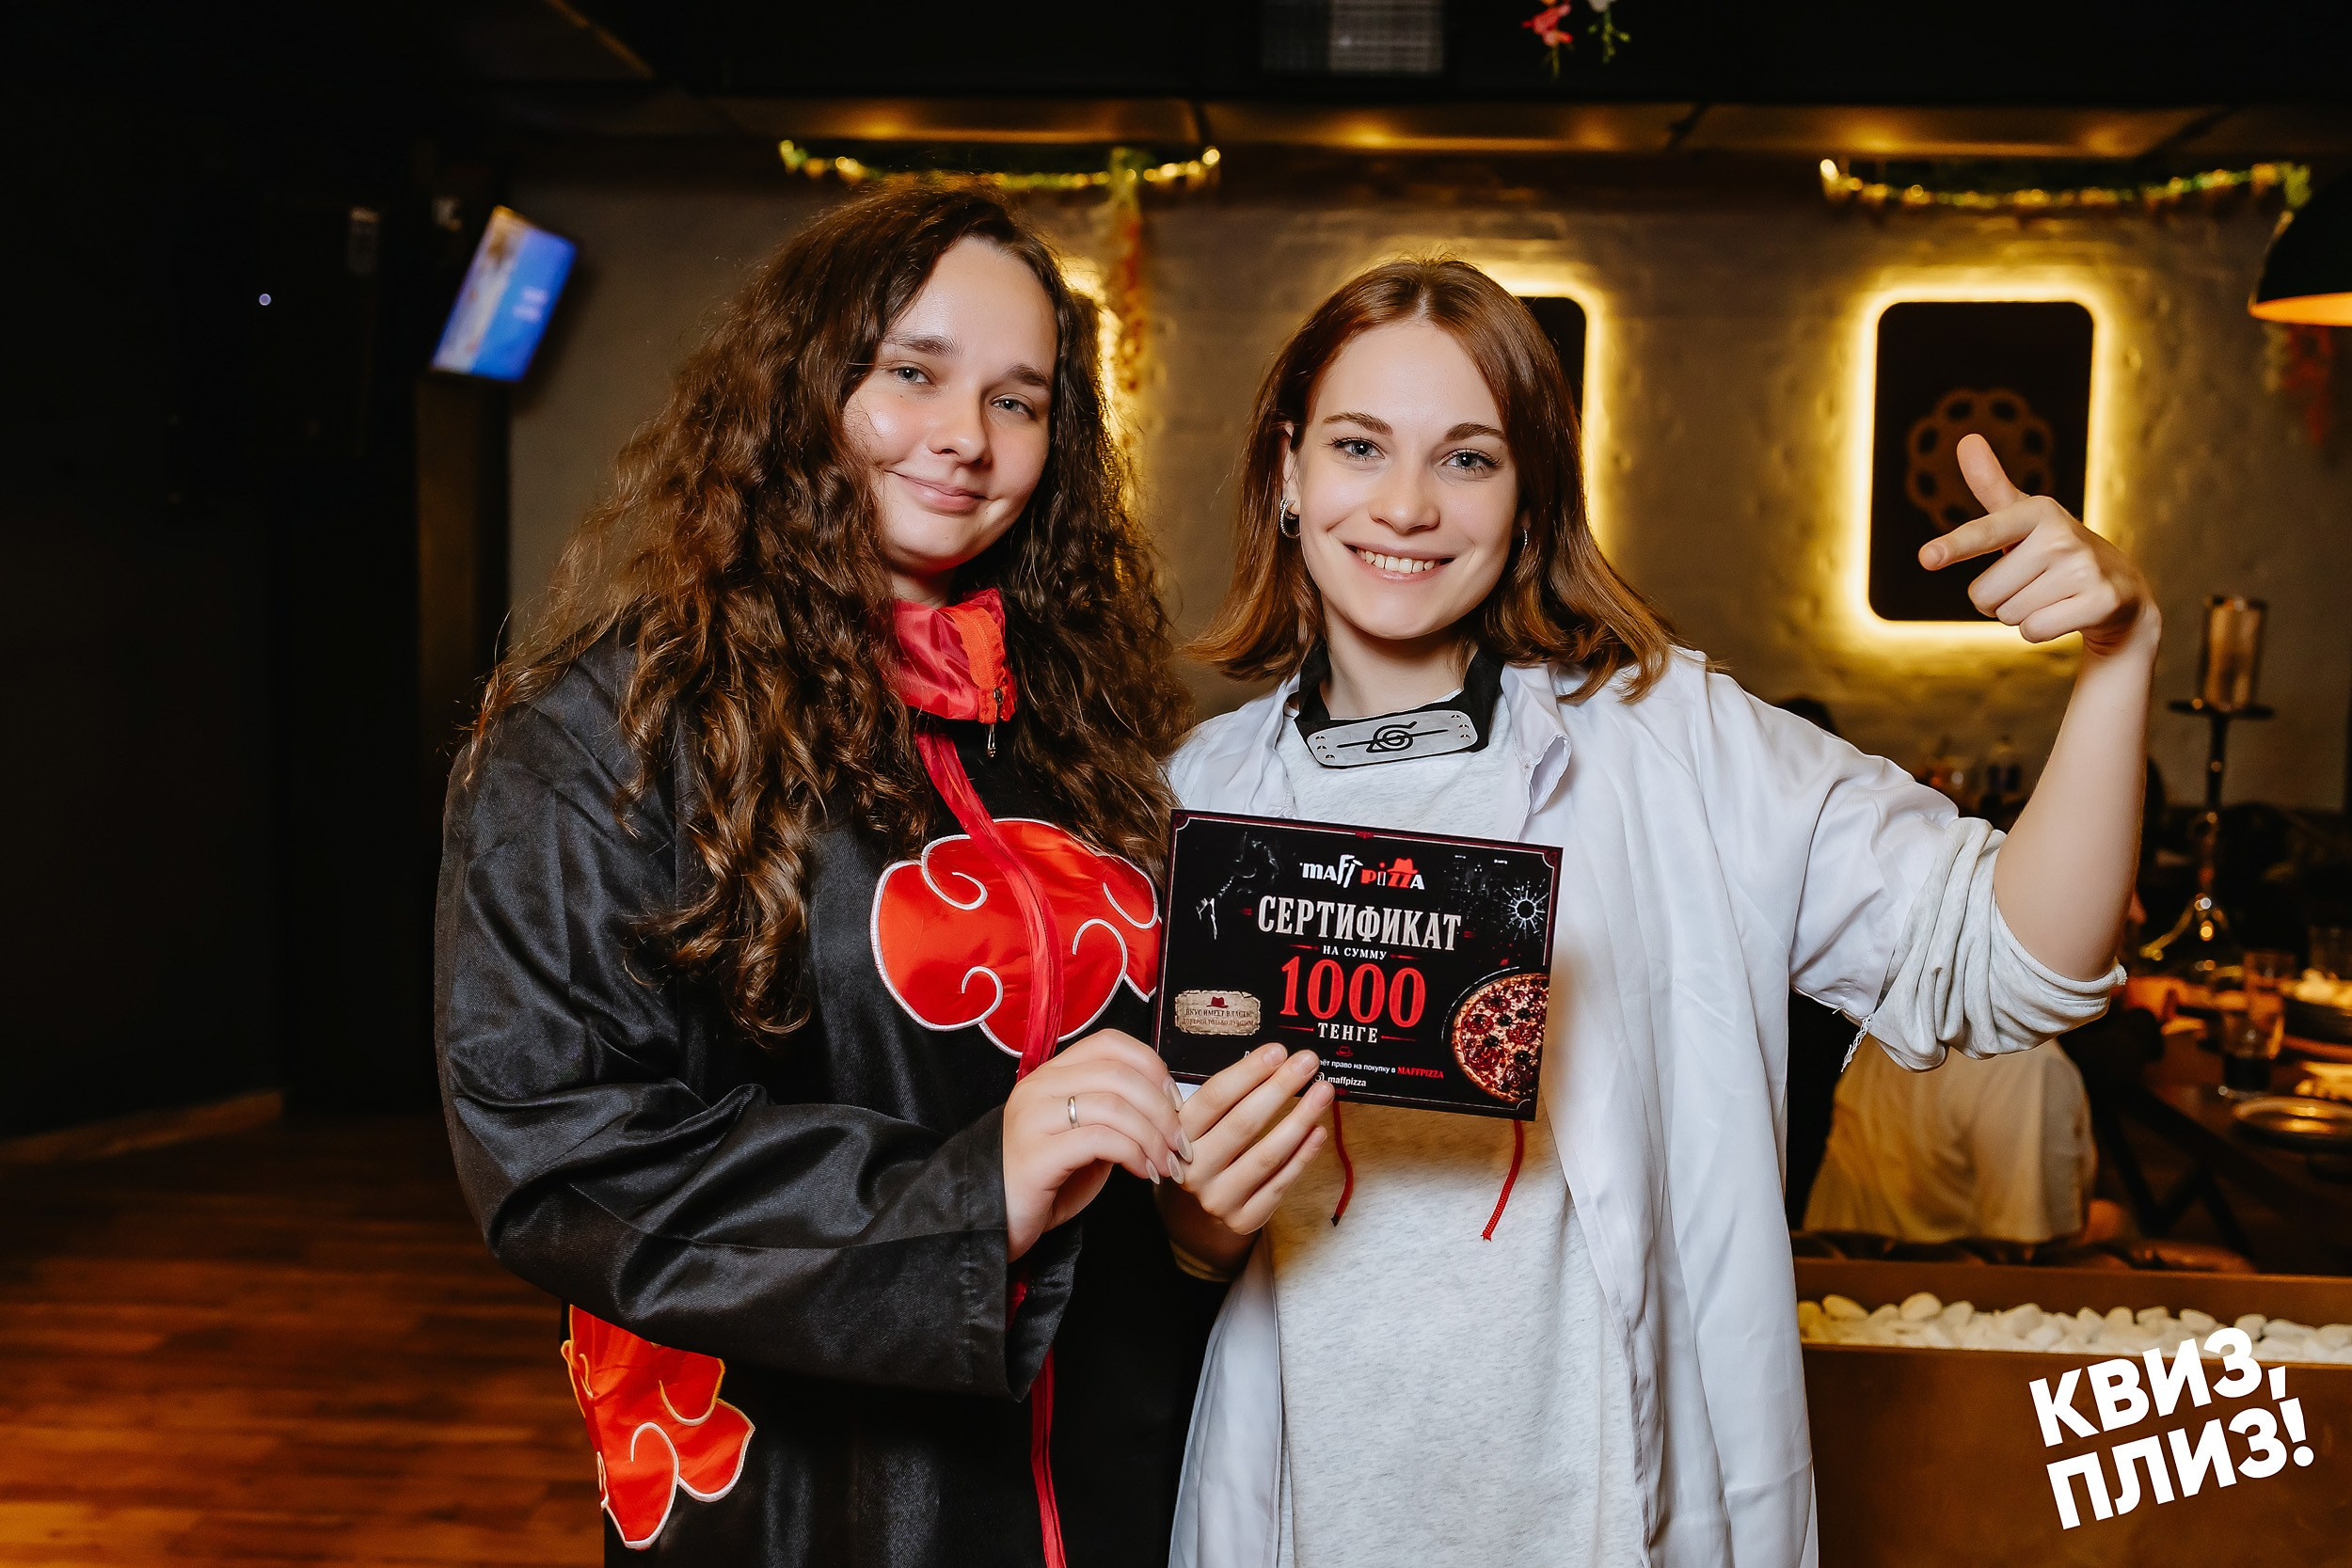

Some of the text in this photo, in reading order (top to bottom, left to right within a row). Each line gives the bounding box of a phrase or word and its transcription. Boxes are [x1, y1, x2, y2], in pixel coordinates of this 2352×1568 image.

[1258, 895, 1462, 951] СЕРТИФИКАТ
[1323, 944, 1387, 960] НА СУММУ
[1279, 956, 1425, 1028] 1000
[1318, 1022, 1378, 1043] ТЕНГЕ
[1331, 1060, 1352, 1070] право
[1363, 1065, 1391, 1074] покупку
[1397, 1066, 1444, 1079] MAFFPIZZA
[1327, 1076, 1367, 1087] maffpizza
